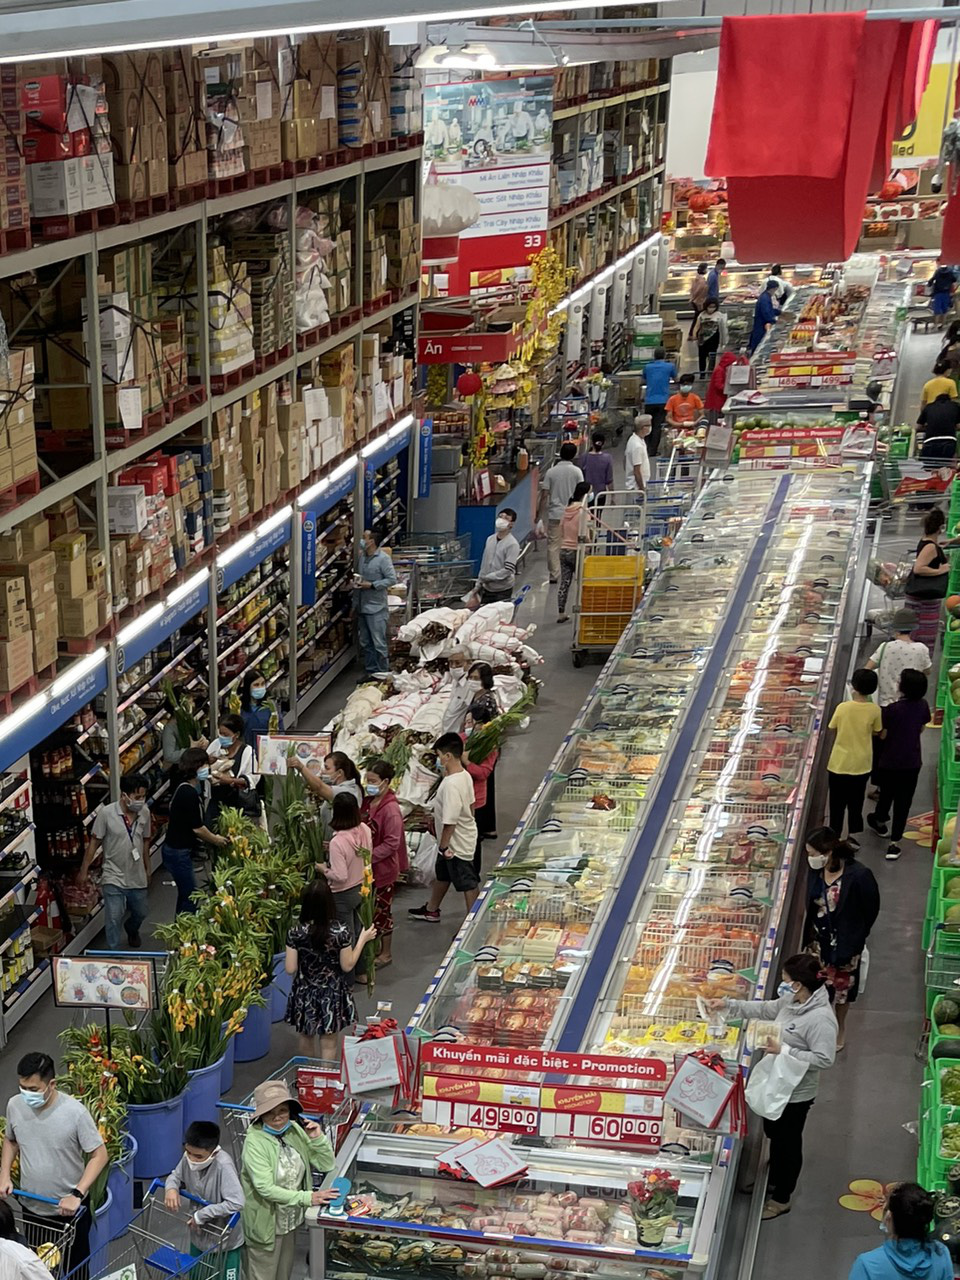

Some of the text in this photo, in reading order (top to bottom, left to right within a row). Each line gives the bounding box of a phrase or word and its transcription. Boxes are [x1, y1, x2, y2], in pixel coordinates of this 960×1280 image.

[524, 235, 541, 248] 33
[424, 341, 442, 355] Ăn
[432, 1046, 656, 1076] Khuyến mãi đặc biệt Promotion
[557, 1093, 585, 1106] KHUYẾN
